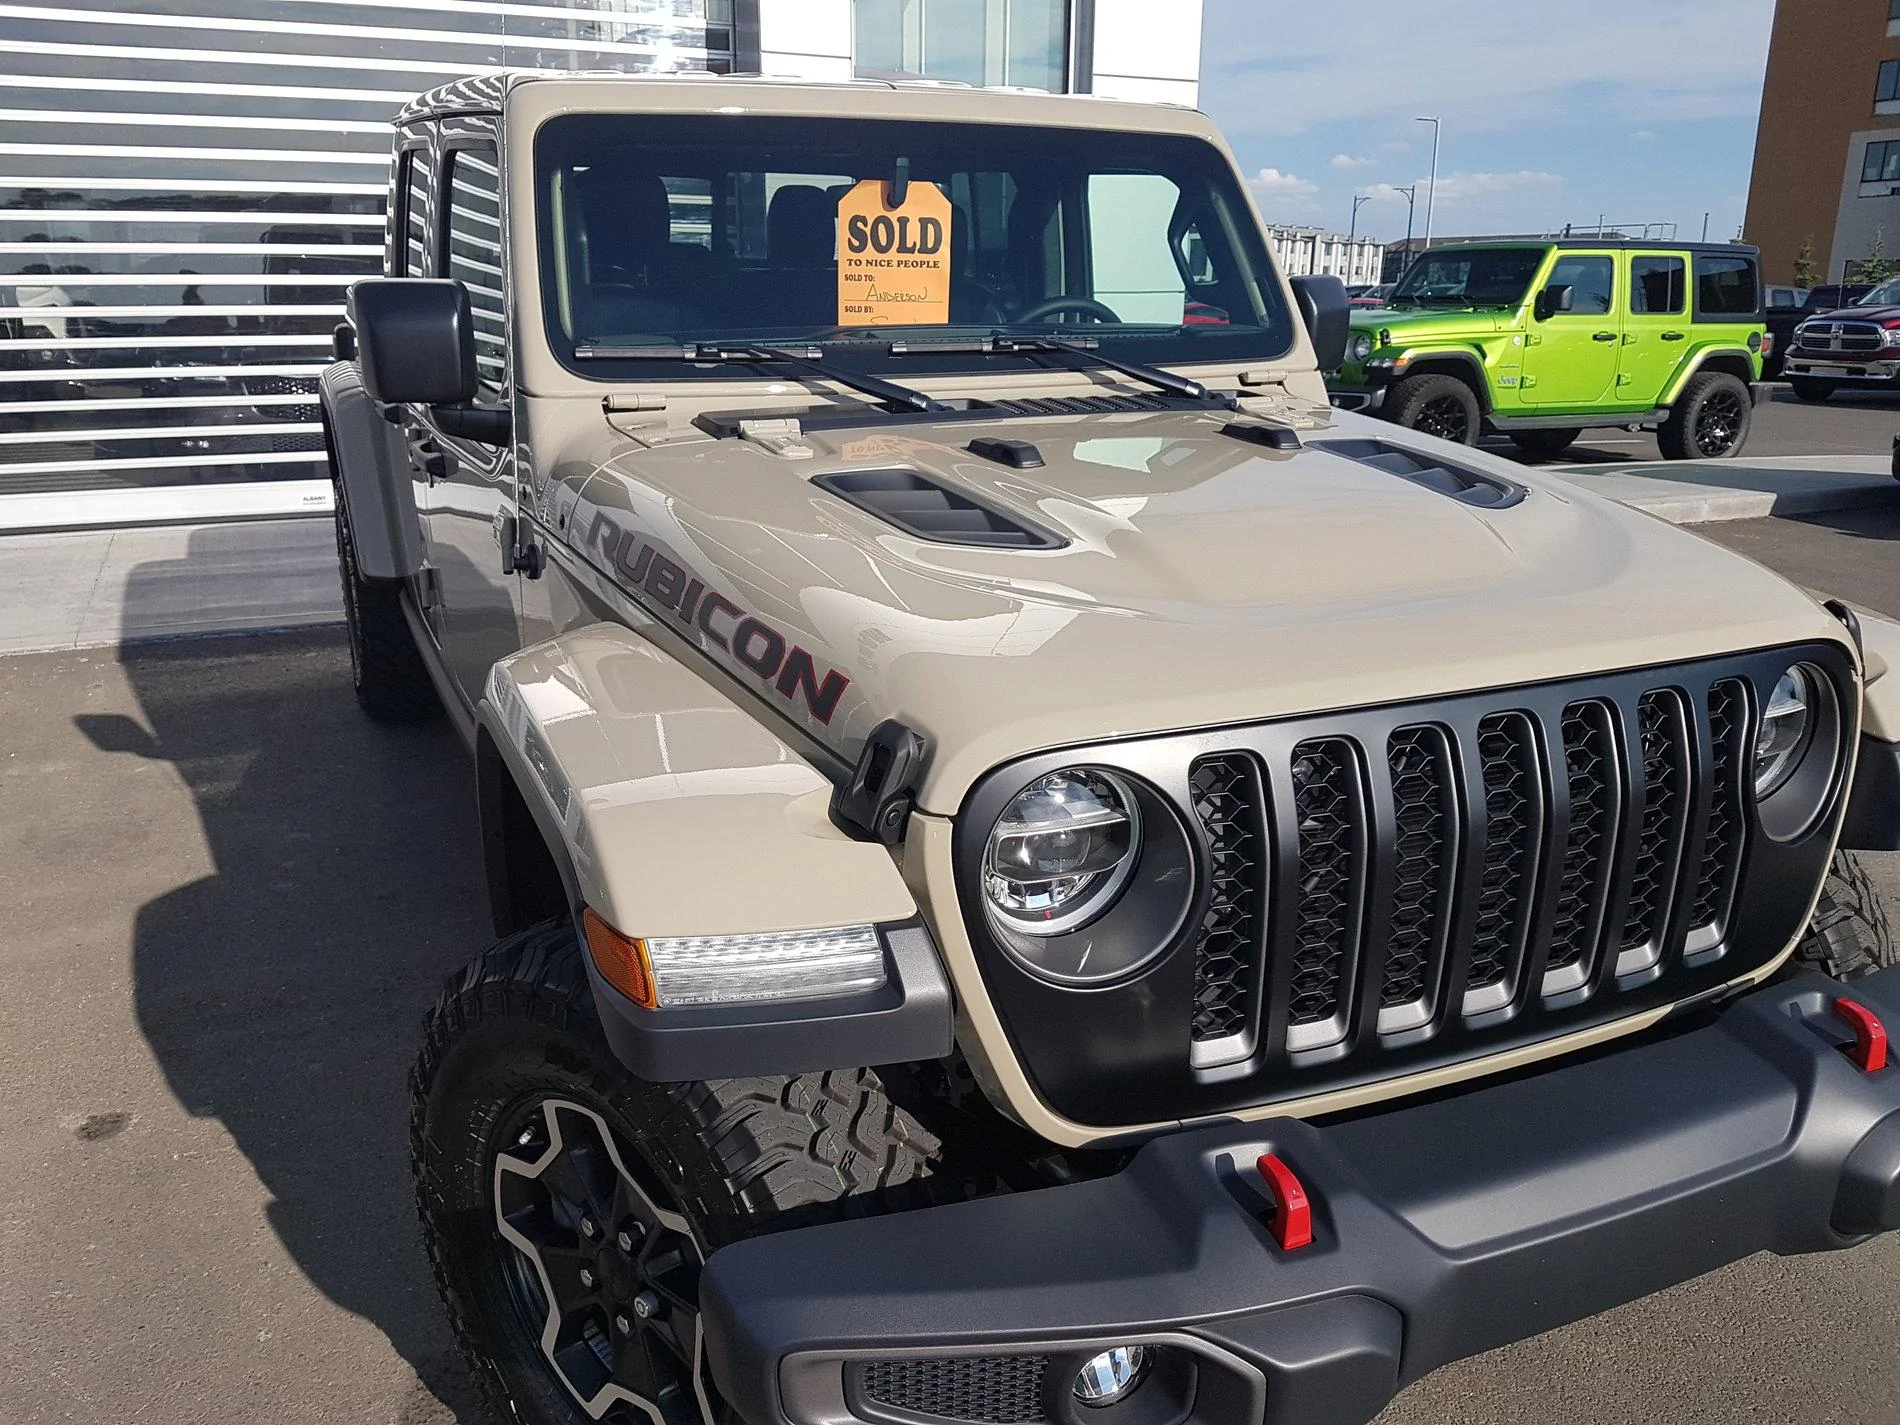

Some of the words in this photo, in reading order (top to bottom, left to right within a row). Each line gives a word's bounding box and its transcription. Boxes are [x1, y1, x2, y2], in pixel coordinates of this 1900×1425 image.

[847, 214, 943, 255] SOLD
[846, 258, 862, 267] TO
[866, 259, 893, 268] NICE
[896, 260, 940, 269] PEOPLE
[844, 273, 862, 282] SOLD
[864, 274, 876, 282] TO:
[844, 305, 862, 313] SOLD
[587, 510, 850, 726] RUBICON
